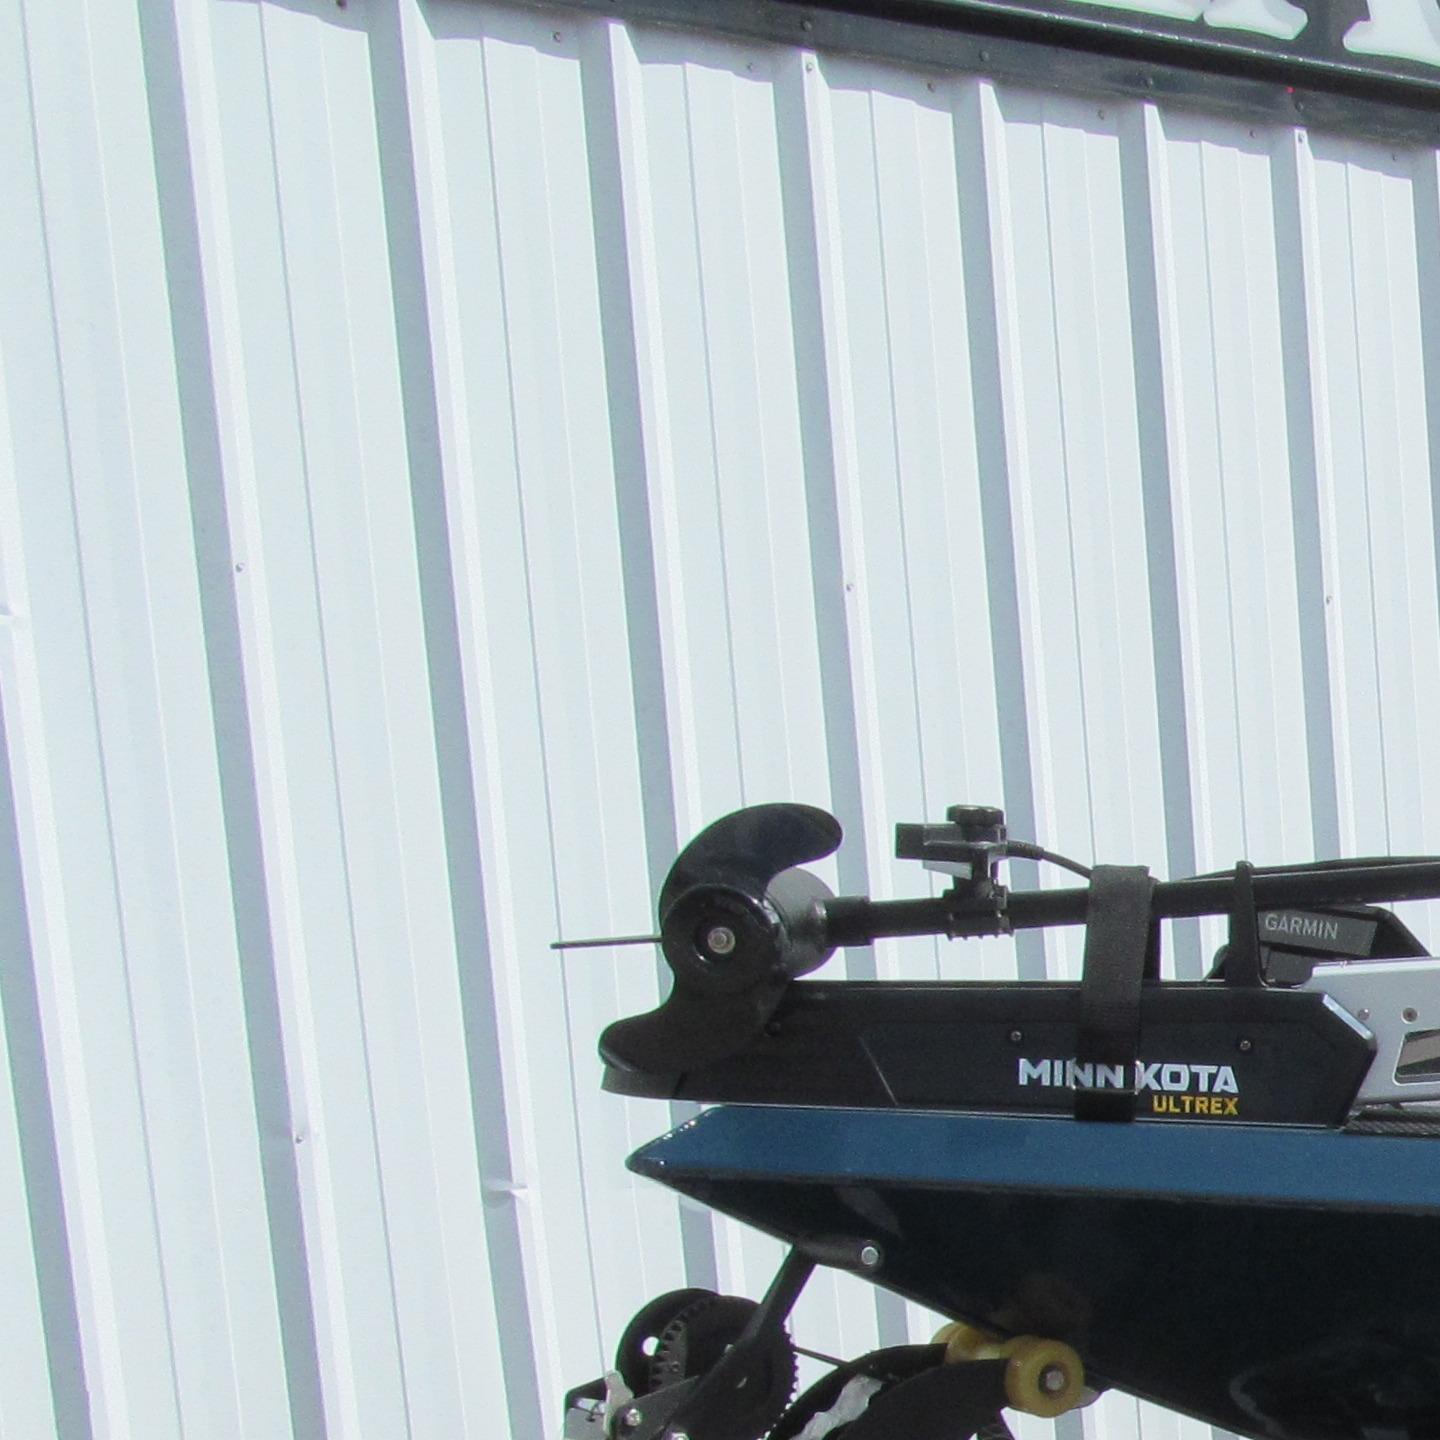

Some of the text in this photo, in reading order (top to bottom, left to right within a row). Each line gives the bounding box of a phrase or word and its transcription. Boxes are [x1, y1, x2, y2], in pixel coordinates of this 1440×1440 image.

[1265, 913, 1338, 939] GARMIN
[1018, 1058, 1239, 1093] MINN KOTA
[1152, 1095, 1239, 1115] ULTREX
